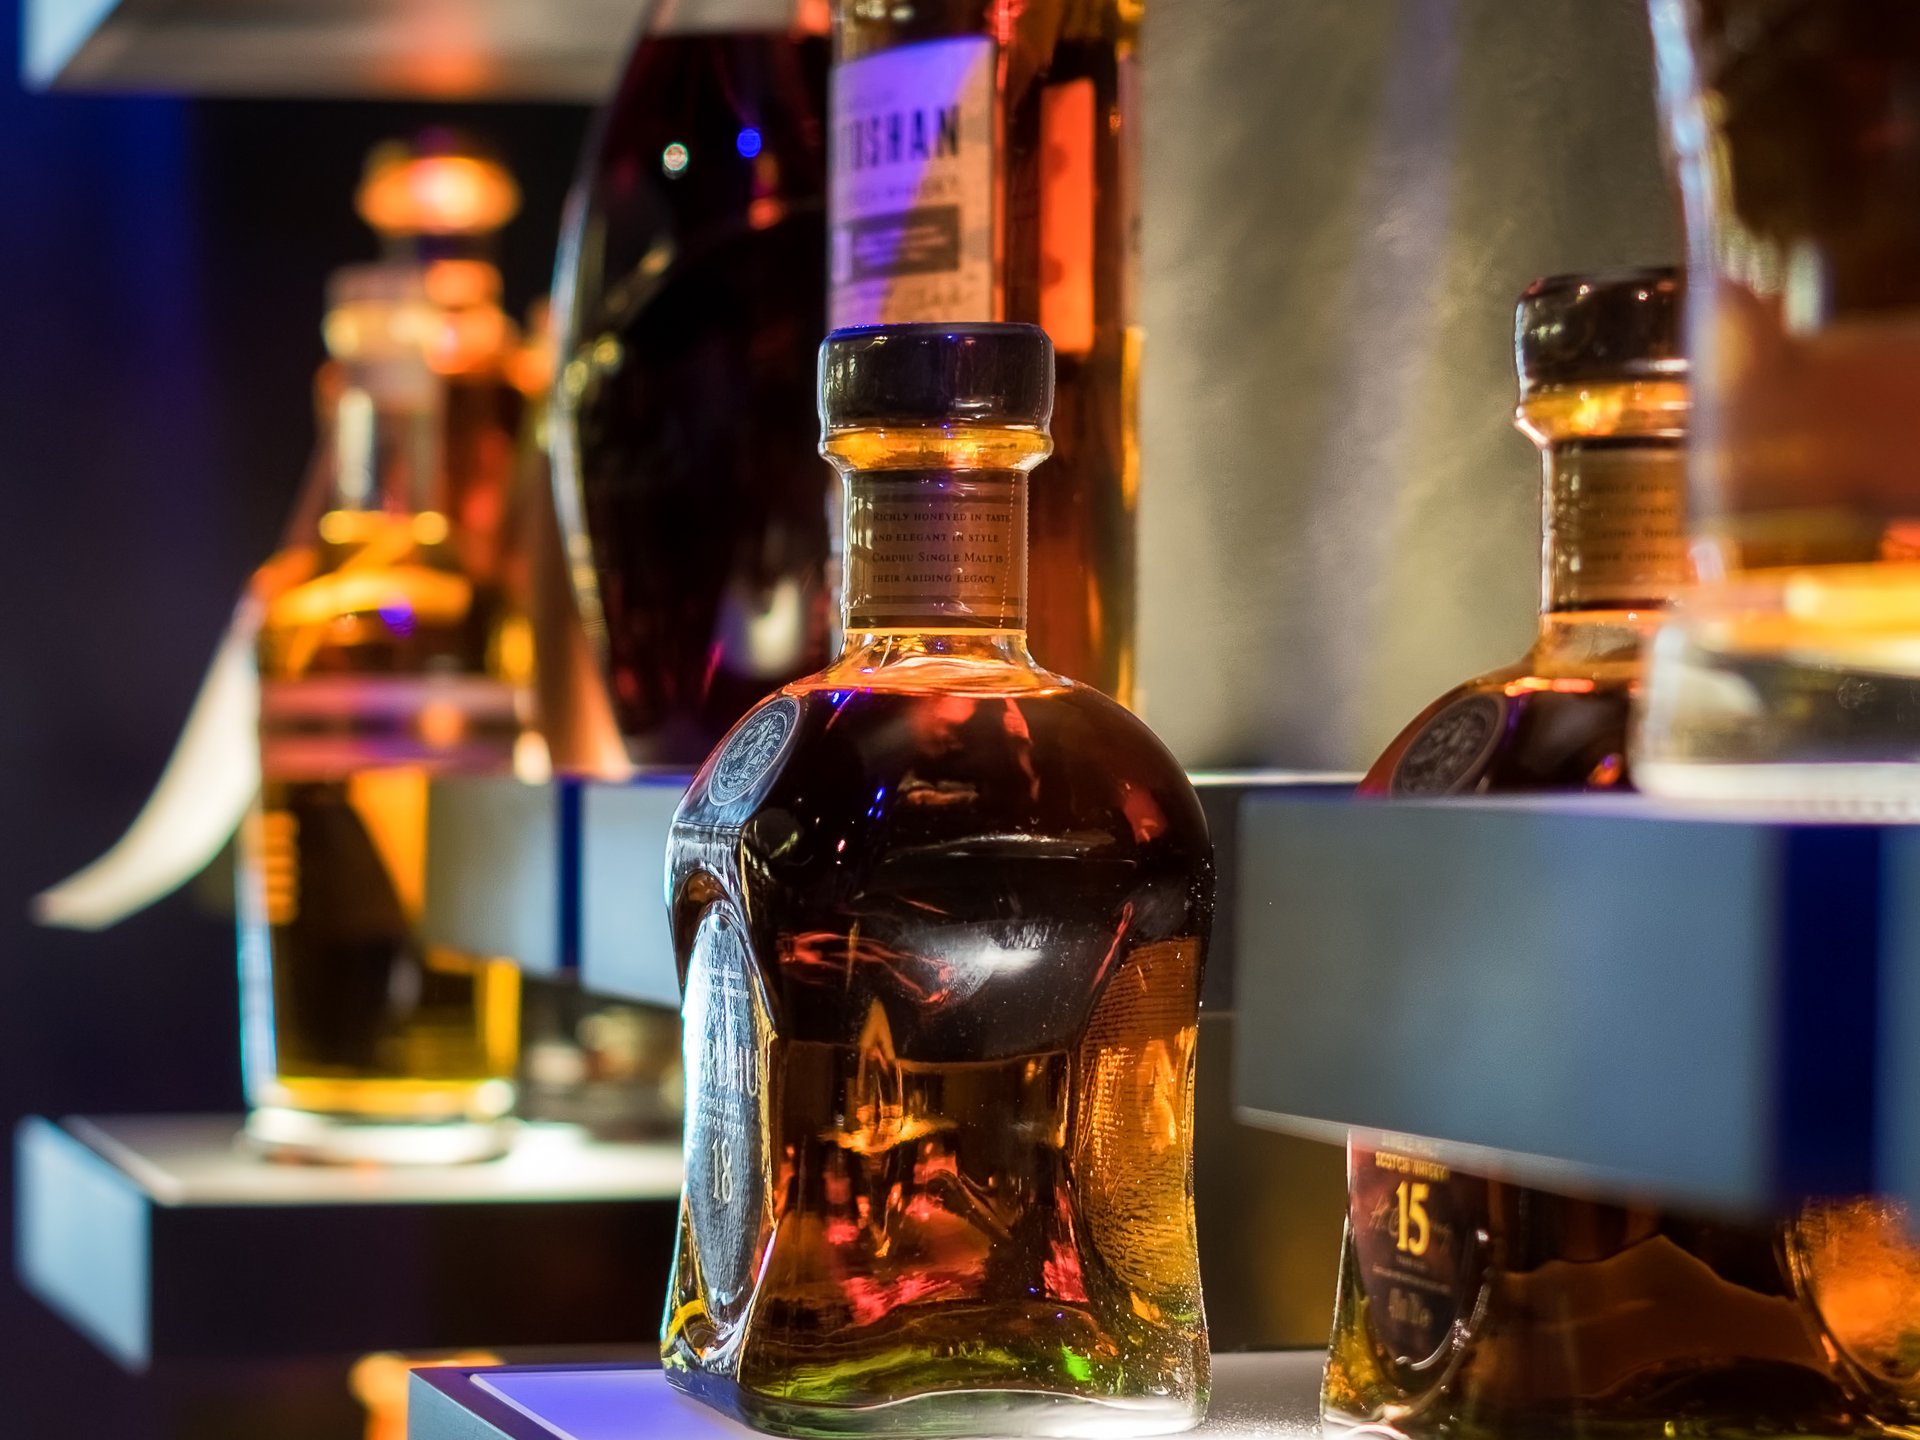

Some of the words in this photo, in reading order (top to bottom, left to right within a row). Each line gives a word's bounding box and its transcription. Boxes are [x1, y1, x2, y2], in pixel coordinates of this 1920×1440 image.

[873, 513, 909, 522] RICHLY
[914, 513, 967, 521] HONEYED
[971, 513, 981, 521] IN
[896, 533, 947, 542] ELEGANT
[952, 533, 964, 542] IN
[968, 534, 999, 543] STYLE
[918, 552, 960, 562] SINGLE
[964, 552, 993, 563] MALT
[905, 574, 952, 583] ABIDING
[956, 574, 996, 584] LEGACY
[711, 1137, 733, 1203] 18
[1396, 1180, 1431, 1257] 15
